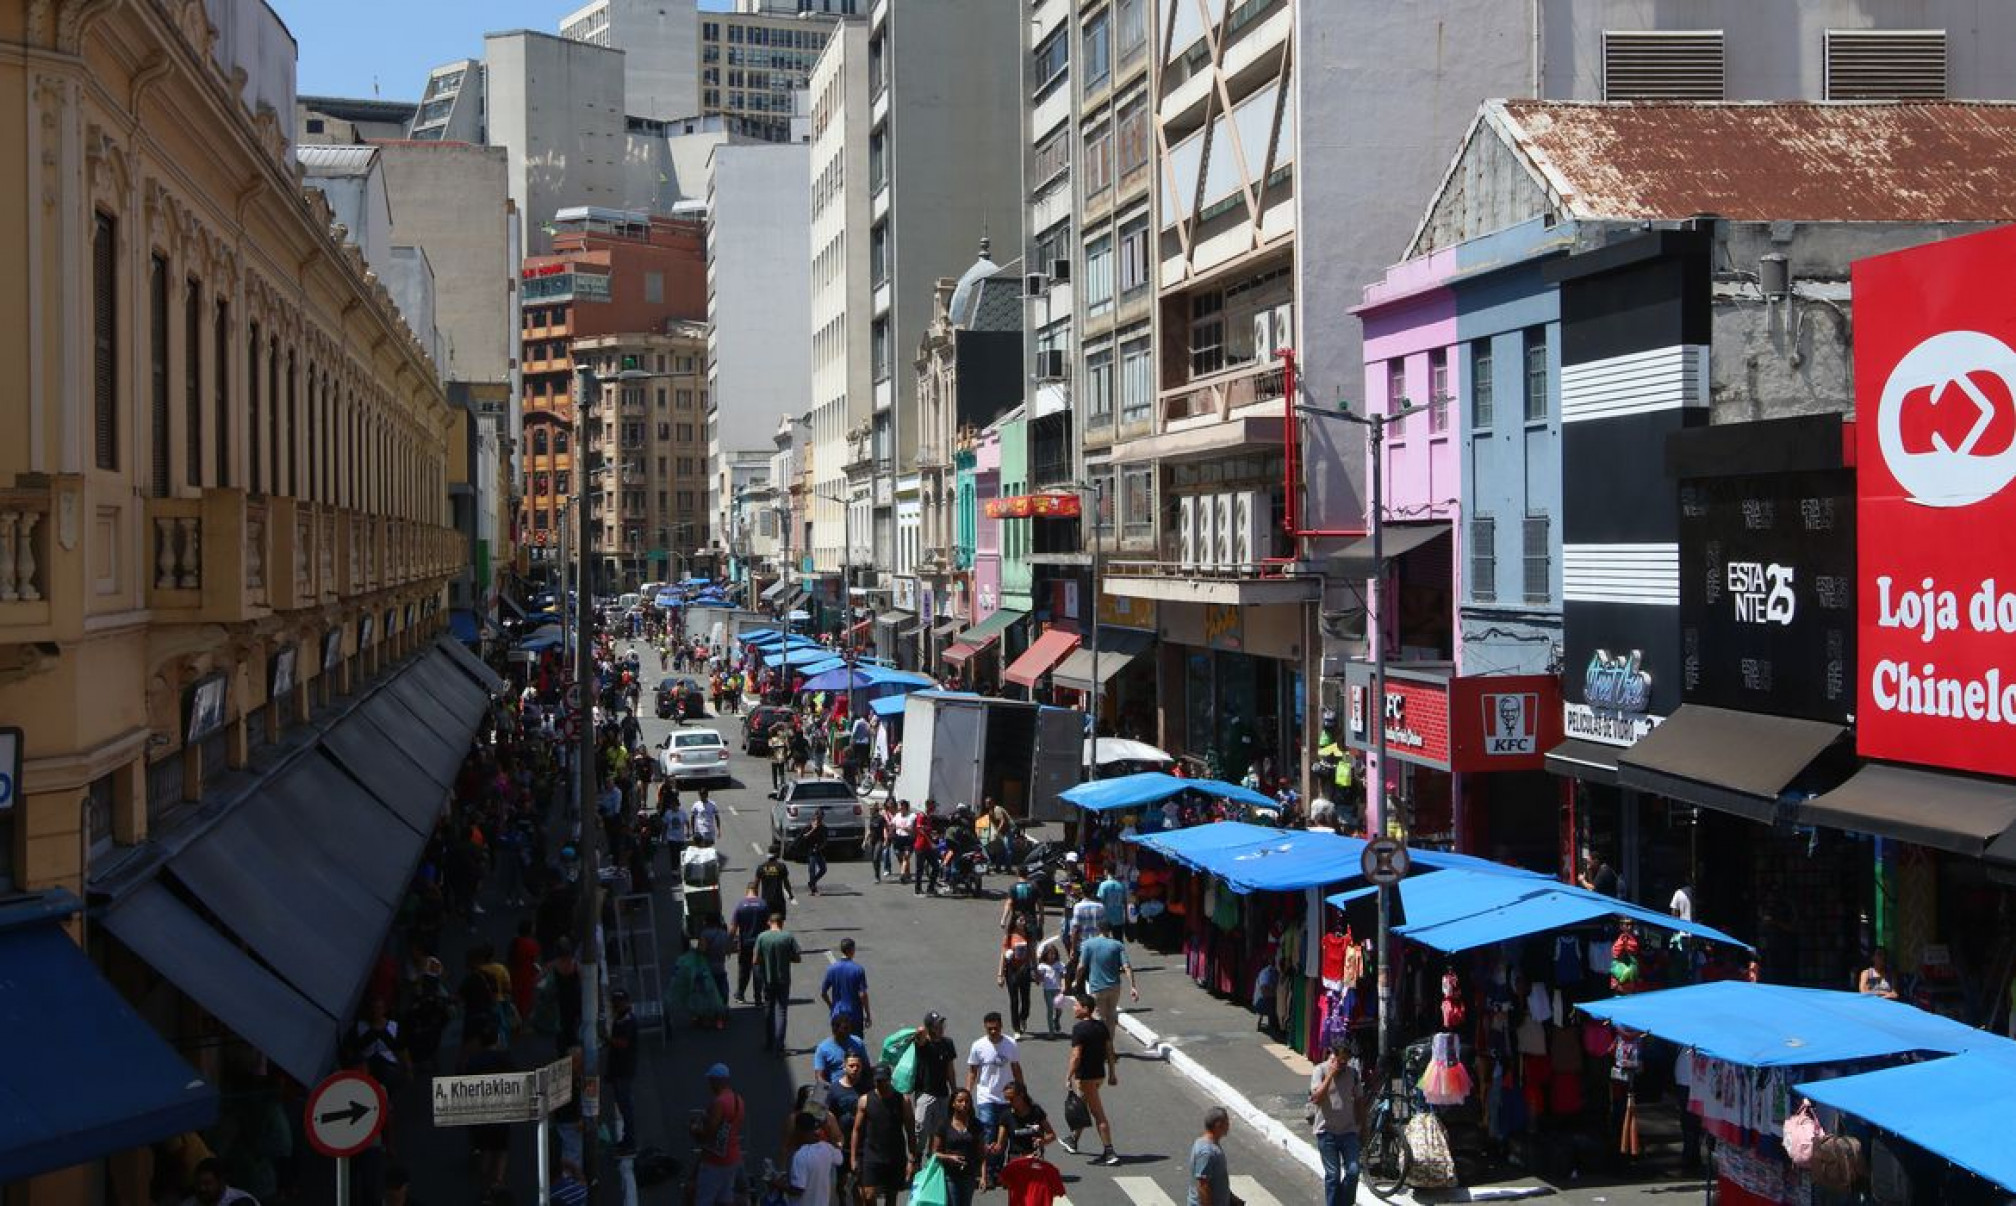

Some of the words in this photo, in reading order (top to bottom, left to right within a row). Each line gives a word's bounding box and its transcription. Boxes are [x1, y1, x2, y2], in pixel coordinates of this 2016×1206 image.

[1727, 562, 1766, 592] ESTA
[1735, 593, 1766, 624] NTE
[1766, 562, 1795, 625] 25
[1876, 575, 1959, 643] Loja
[1386, 693, 1402, 720] FC
[1494, 738, 1529, 752] KFC
